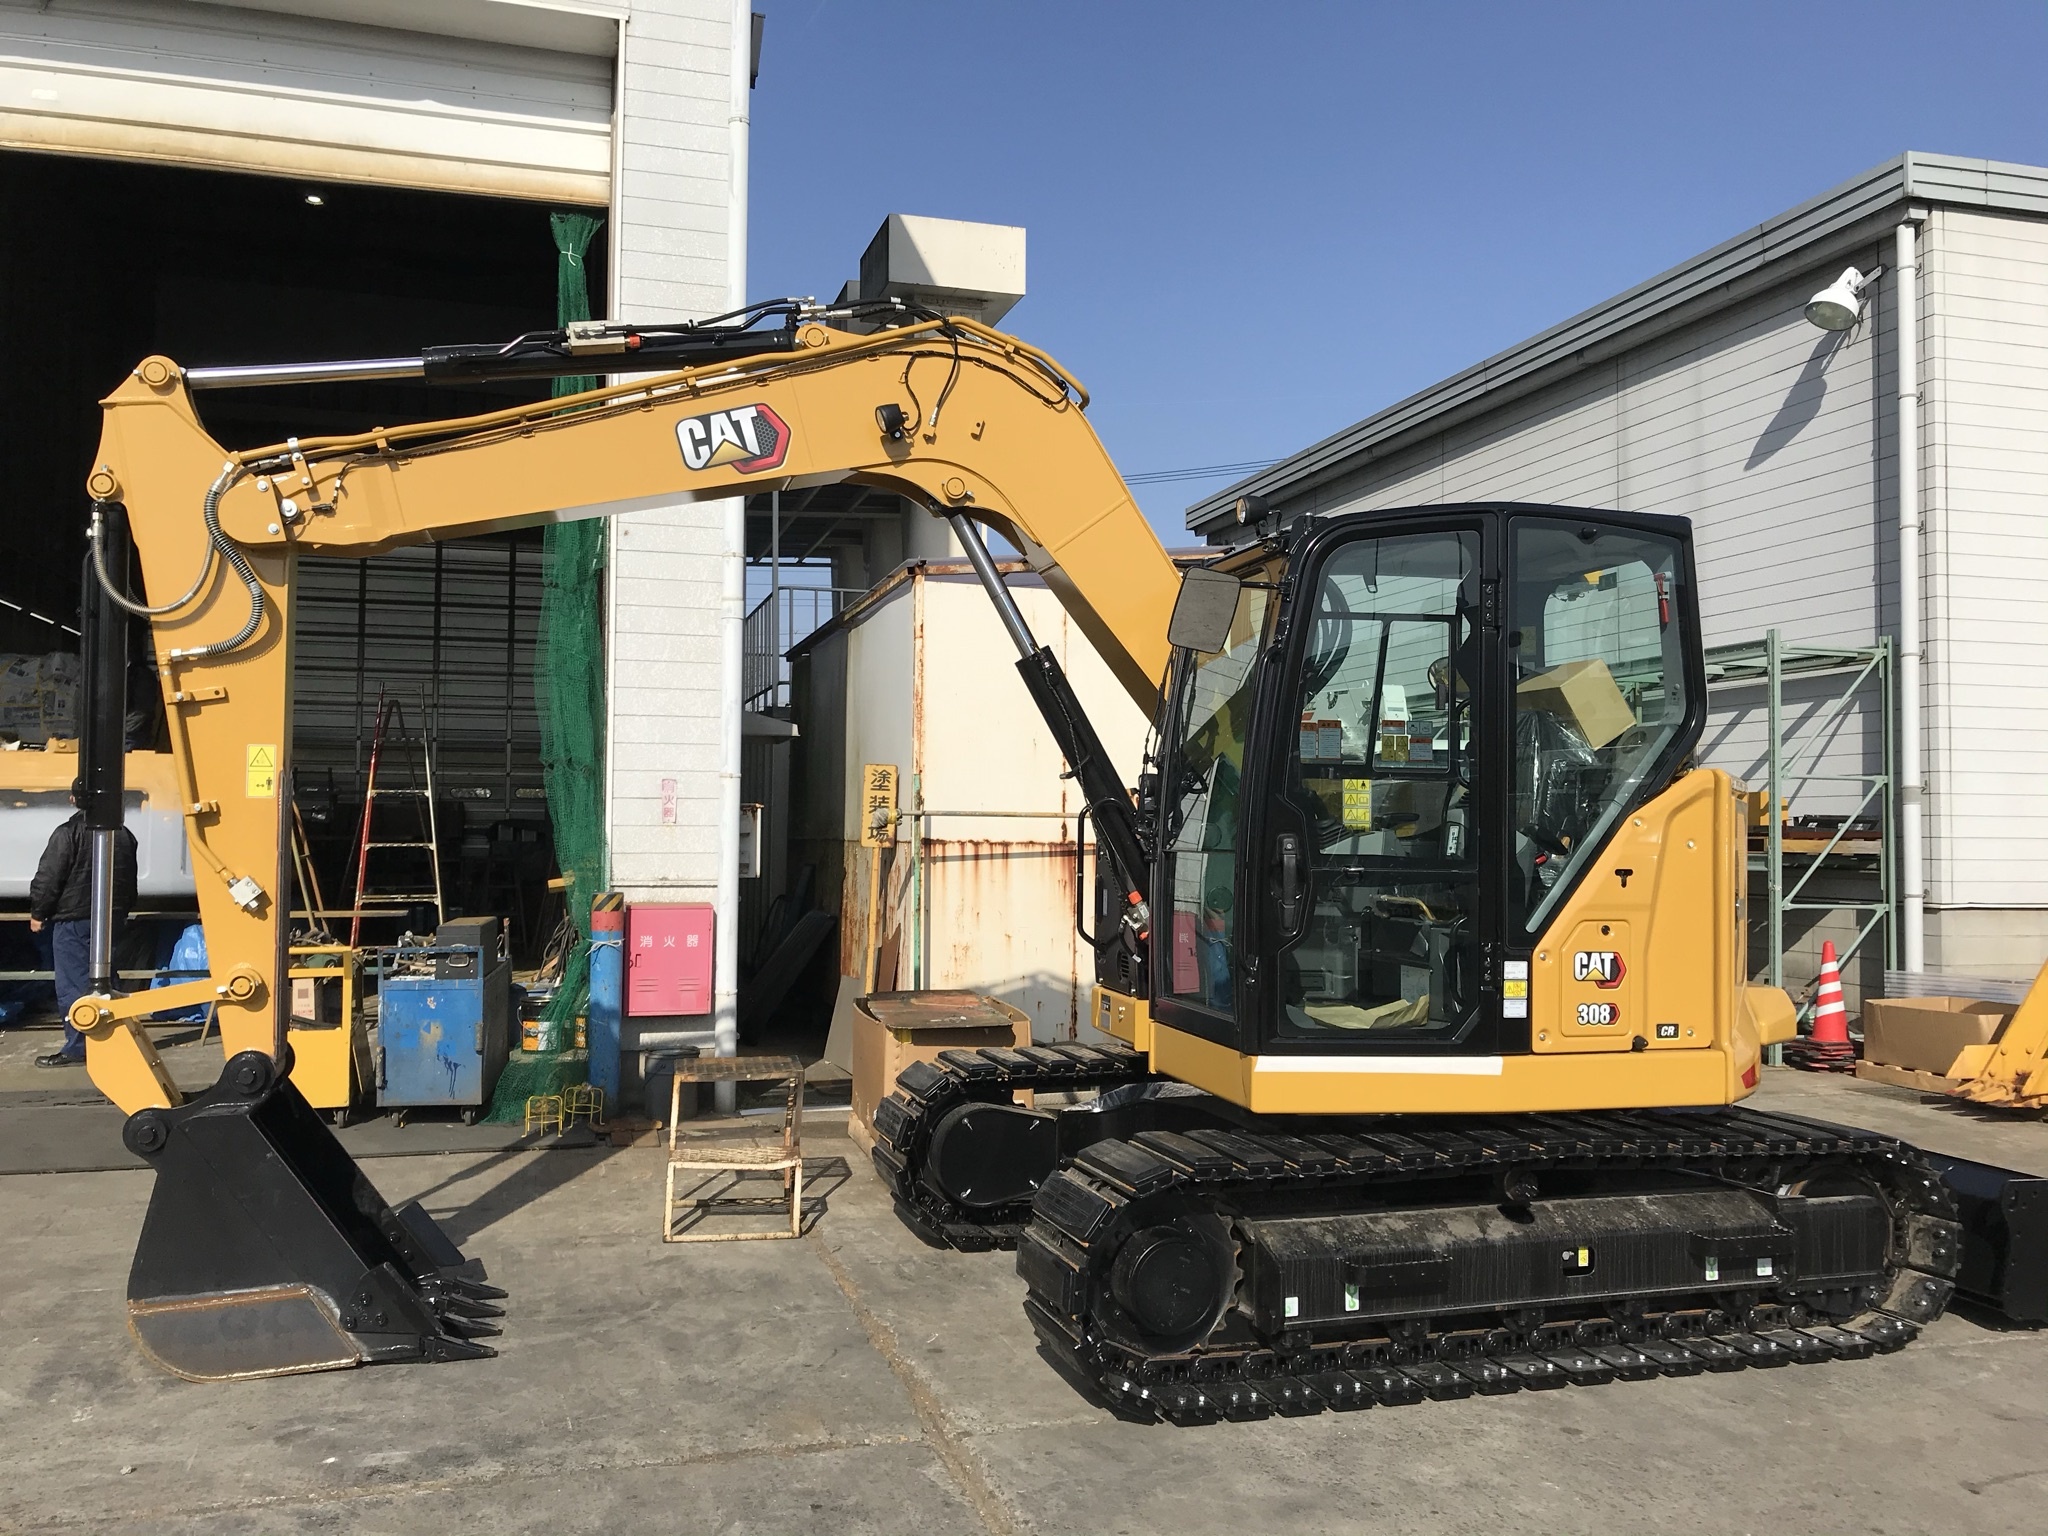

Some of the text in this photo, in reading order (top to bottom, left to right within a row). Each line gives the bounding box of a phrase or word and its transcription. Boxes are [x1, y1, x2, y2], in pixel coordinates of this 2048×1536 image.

[677, 406, 760, 469] CAT
[640, 934, 699, 947] 消火器
[1575, 952, 1614, 980] CAT
[1578, 1004, 1611, 1024] 308
[1661, 1026, 1675, 1036] CR
